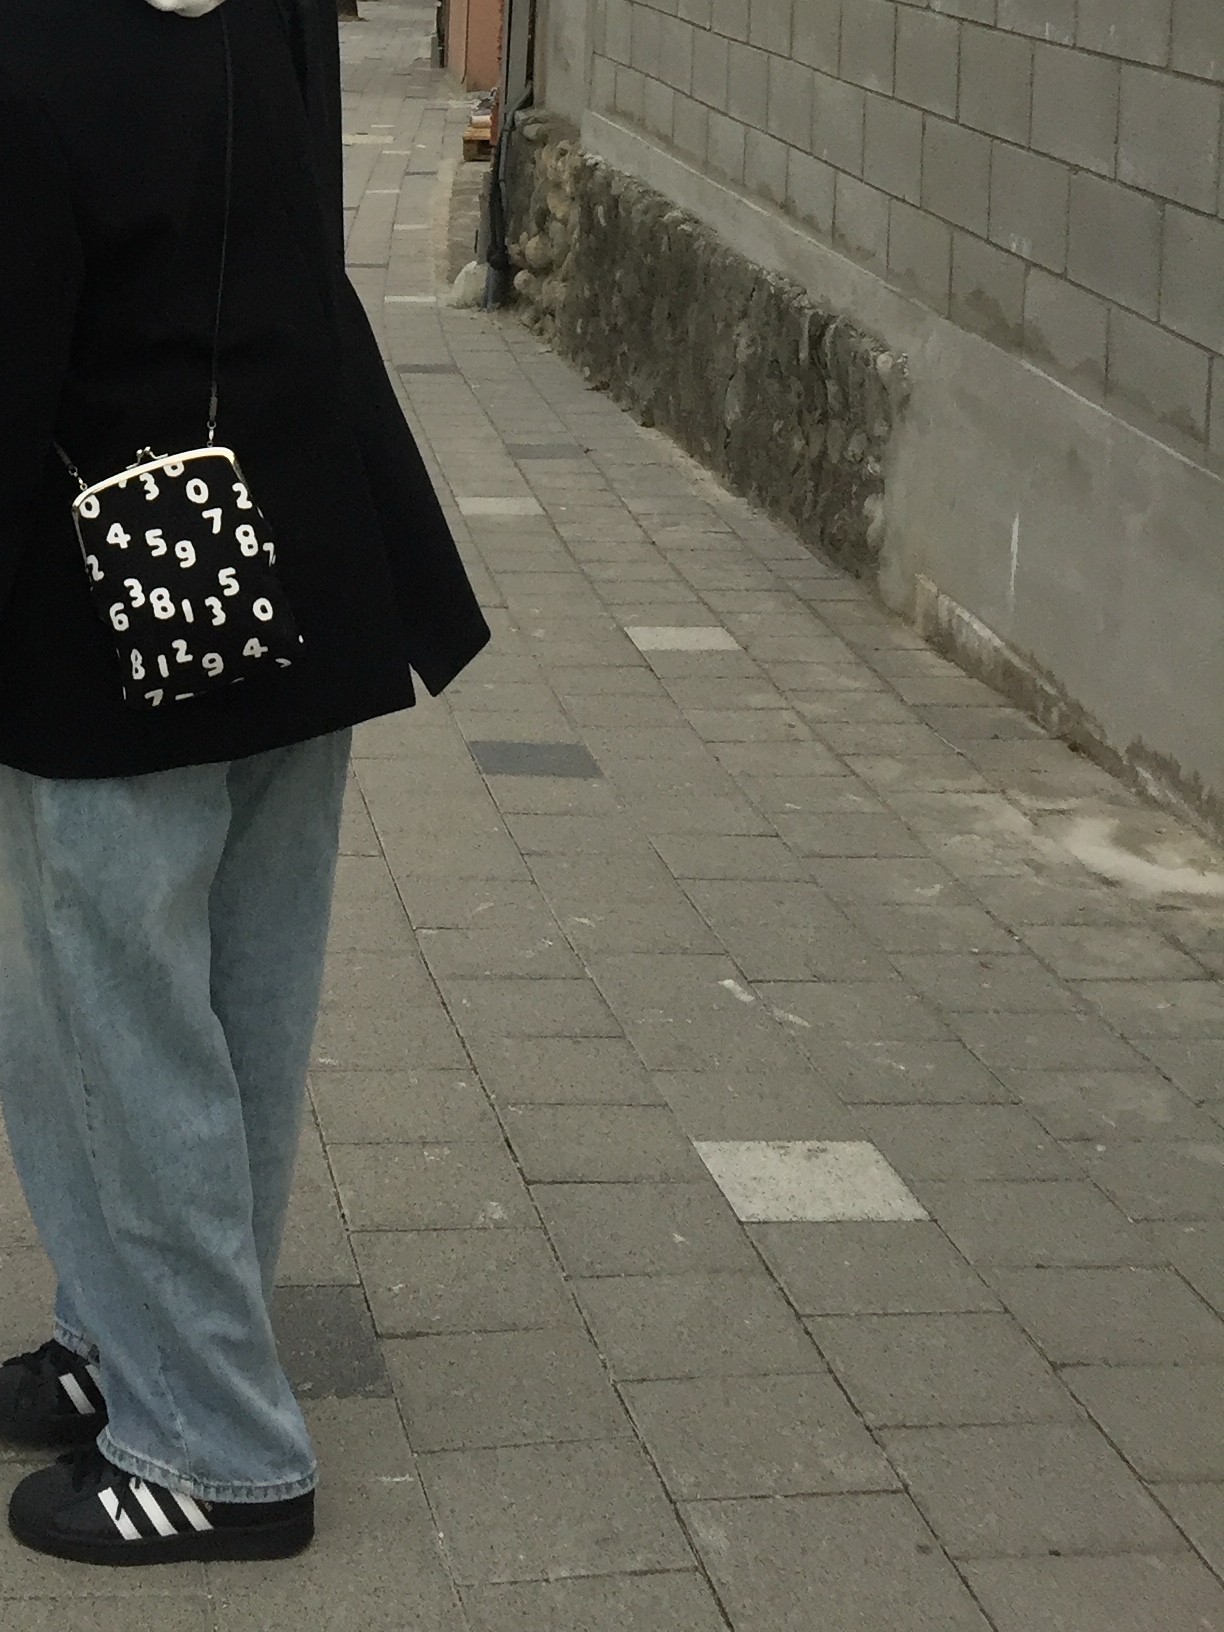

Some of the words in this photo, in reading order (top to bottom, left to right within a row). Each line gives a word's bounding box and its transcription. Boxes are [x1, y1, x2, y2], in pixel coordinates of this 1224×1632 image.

[186, 478, 209, 504] 0
[232, 482, 253, 510] 2
[106, 522, 131, 549] 4
[202, 507, 222, 535] 7
[145, 528, 167, 557] 5
[175, 539, 197, 568] 9
[235, 524, 258, 557] 8
[124, 577, 146, 608] 3
[218, 566, 240, 597] 5
[109, 602, 130, 632] 6
[149, 586, 176, 620] 8
[204, 595, 227, 626] 3
[252, 597, 274, 622] 0
[172, 638, 193, 663] 2
